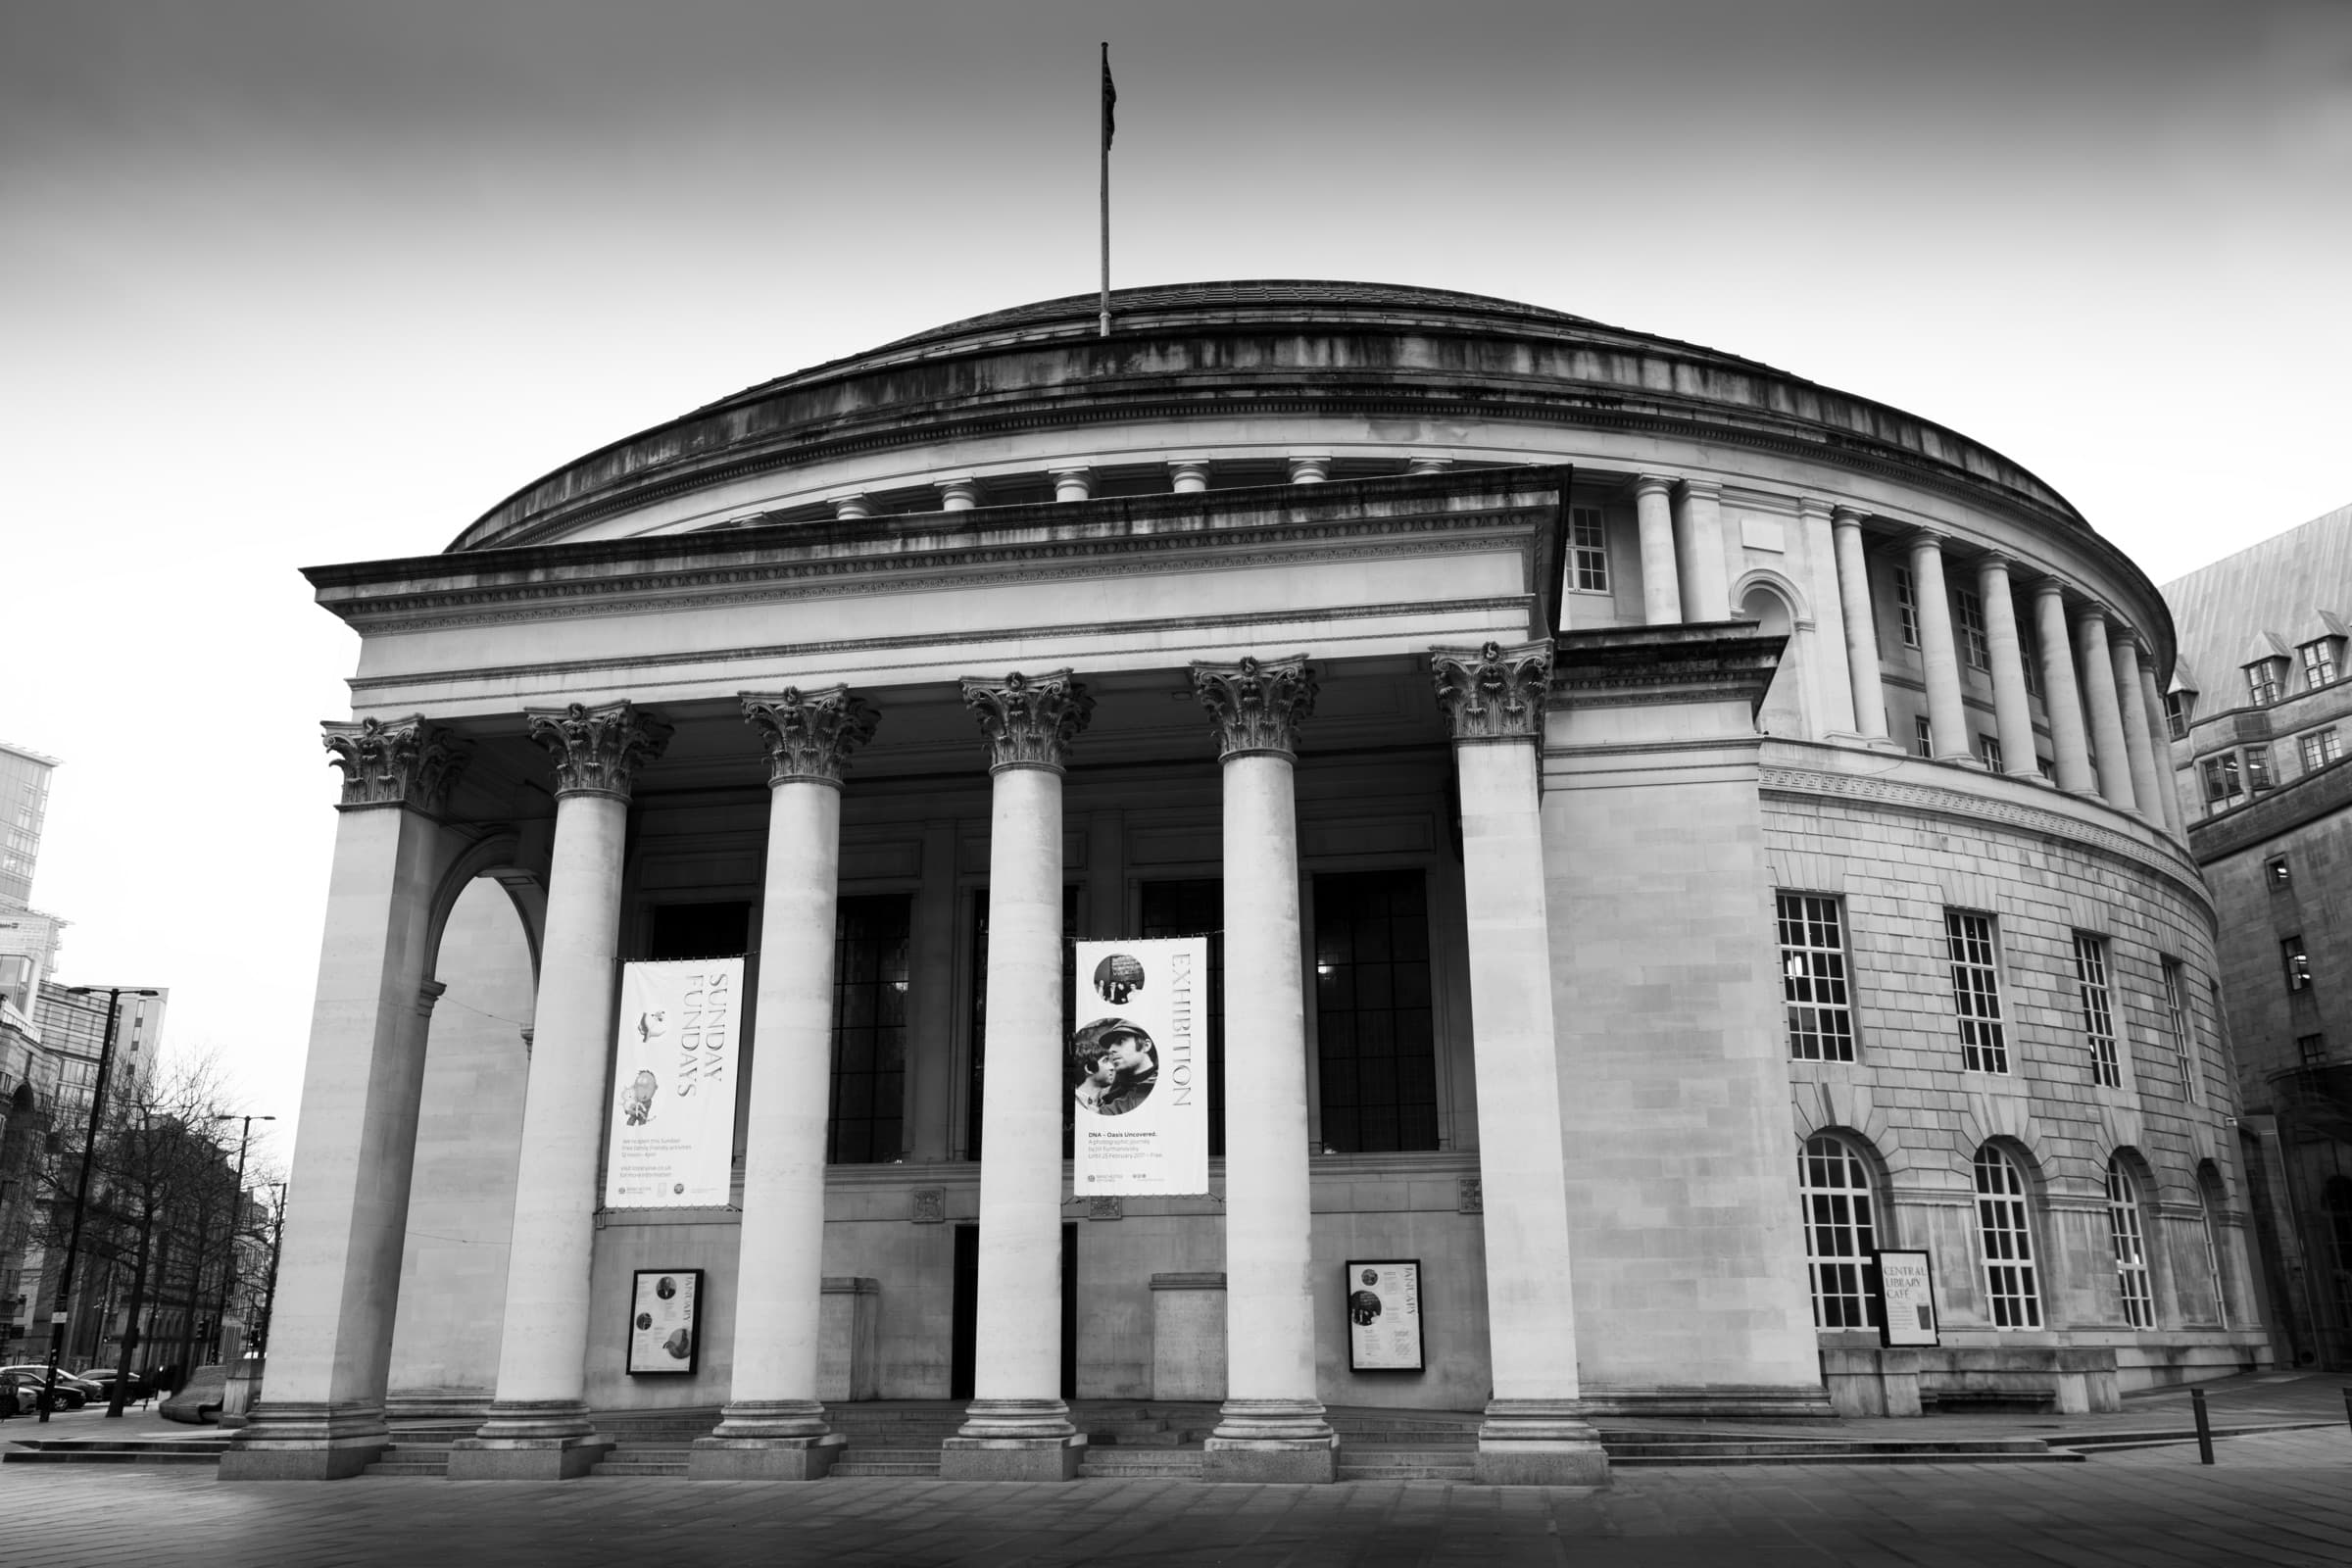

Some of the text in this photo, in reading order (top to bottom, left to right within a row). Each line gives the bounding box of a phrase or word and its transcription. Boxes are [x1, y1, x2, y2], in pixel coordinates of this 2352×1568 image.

[677, 974, 705, 1098] FUNDAYS
[705, 973, 728, 1082] SUNDAY
[1172, 954, 1192, 1106] EXHIBITION
[1884, 1266, 1927, 1276] CENTRAL
[1885, 1277, 1921, 1287] LIBRARY
